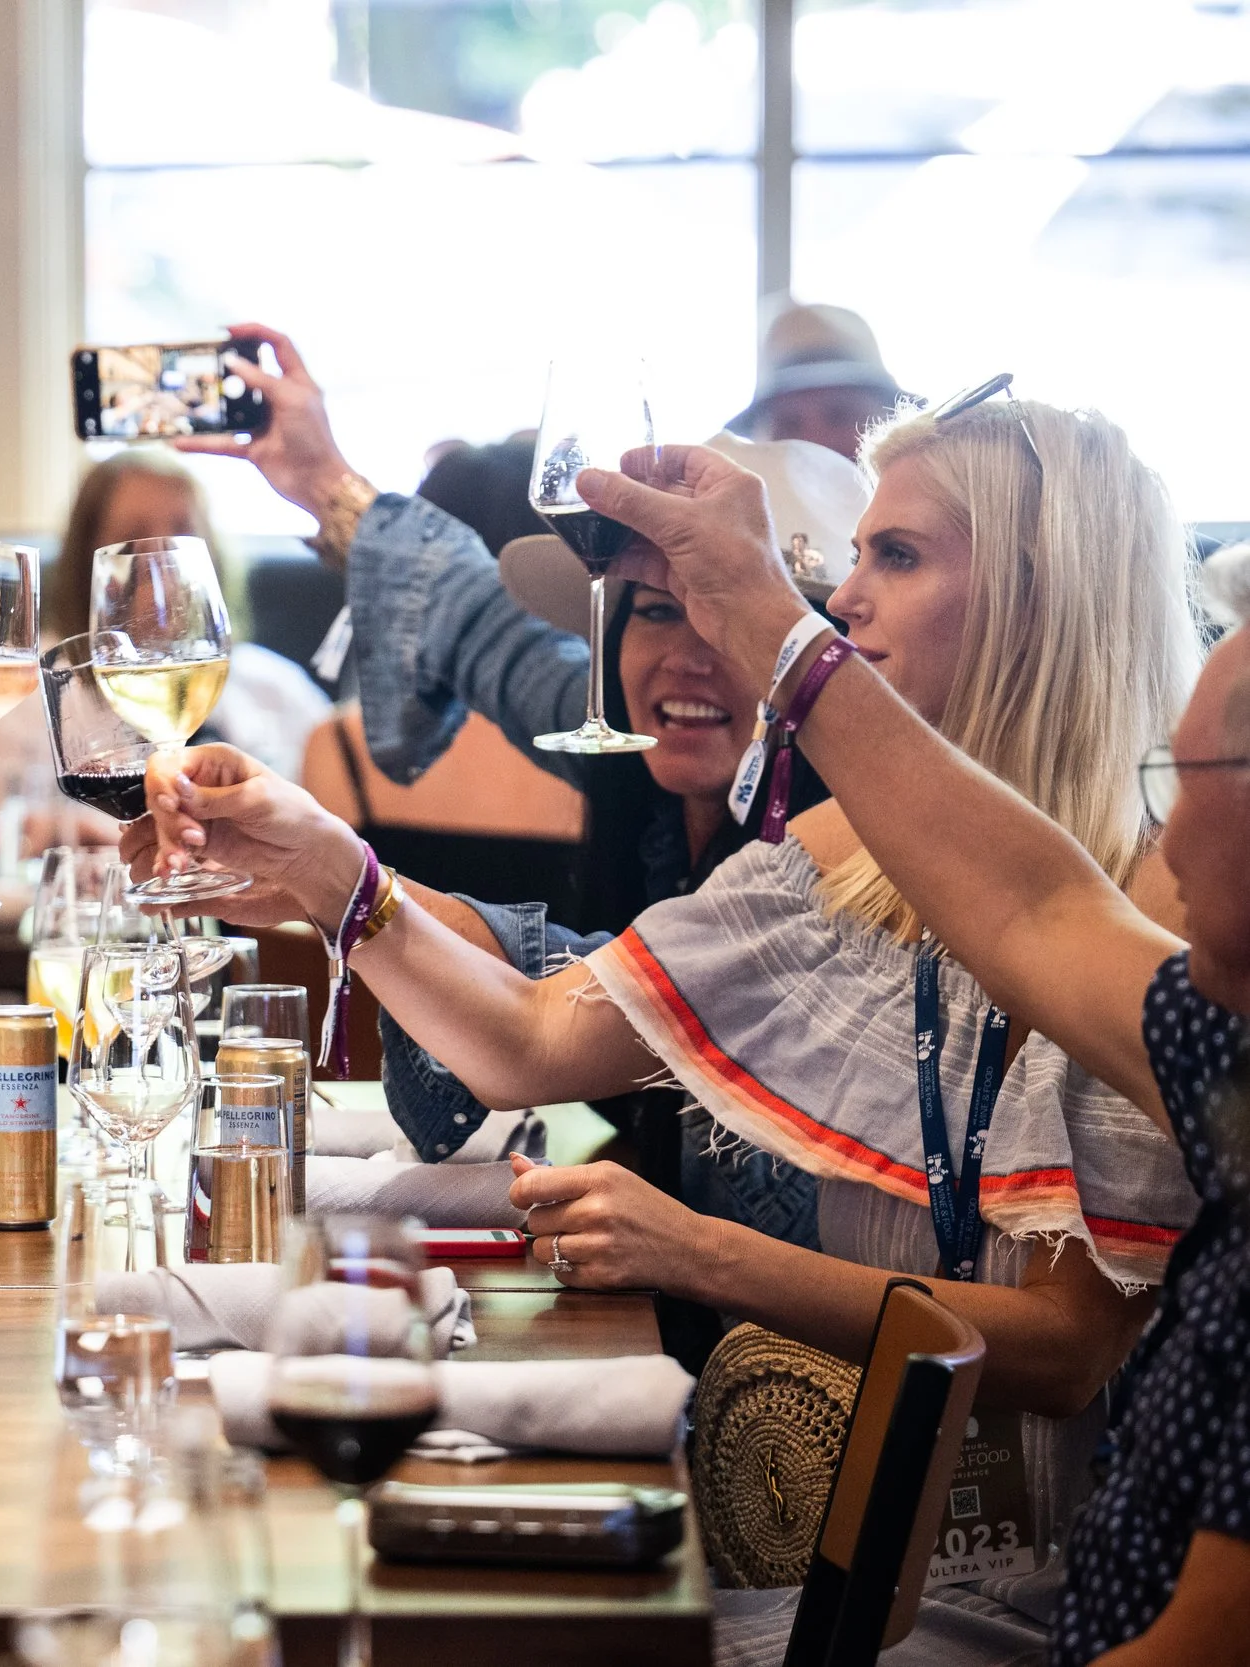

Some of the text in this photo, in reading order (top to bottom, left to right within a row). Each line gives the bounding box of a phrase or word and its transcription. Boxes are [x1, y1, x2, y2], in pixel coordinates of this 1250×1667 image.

[1, 1083, 39, 1091] ESSENZA
[983, 1066, 993, 1093] FOOD
[925, 1092, 933, 1118] FOOD
[229, 1121, 260, 1129] ESSENZA
[937, 1185, 948, 1209] WINE
[967, 1197, 977, 1224] FOOD
[968, 1449, 1011, 1467] FOOD
[930, 1557, 1015, 1578] ULTRA VIP
